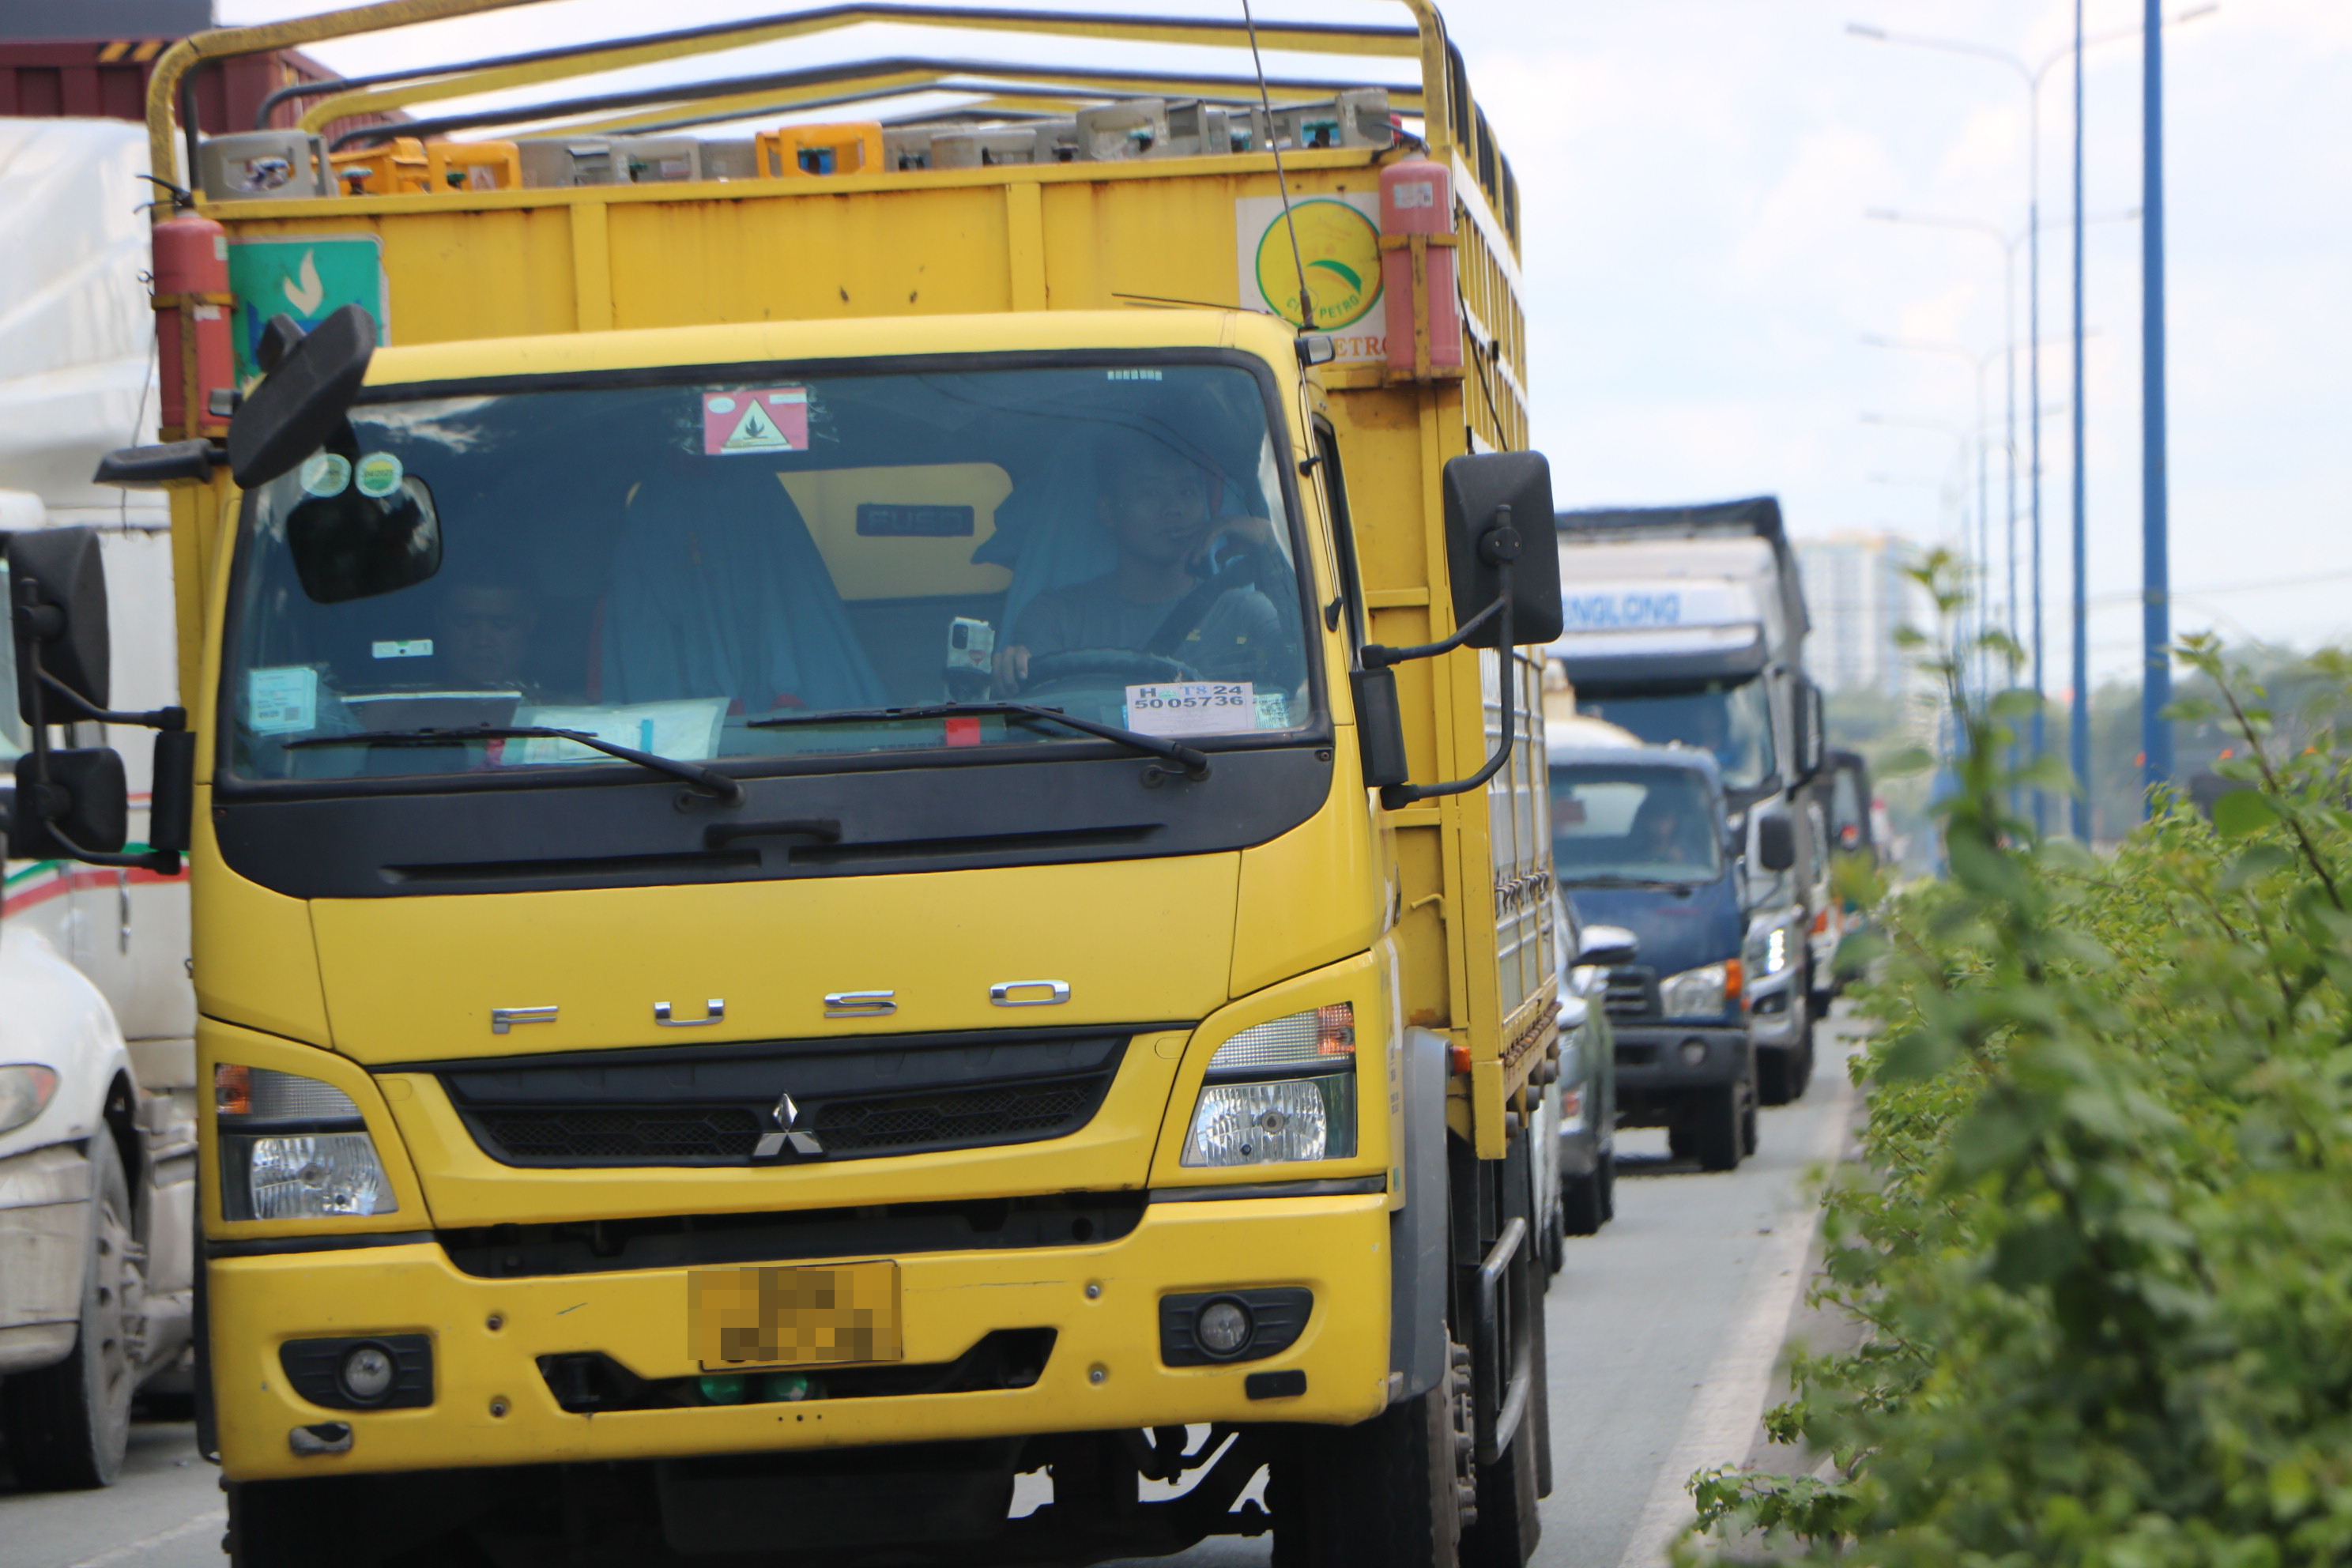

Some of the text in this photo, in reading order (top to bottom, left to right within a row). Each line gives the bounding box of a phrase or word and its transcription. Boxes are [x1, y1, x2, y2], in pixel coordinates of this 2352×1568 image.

[1319, 293, 1359, 319] PETRO
[1334, 336, 1386, 357] ETR
[869, 511, 963, 530] FUSO
[1140, 687, 1156, 698] H
[1213, 685, 1243, 695] 24
[492, 979, 1071, 1034] FUSO
